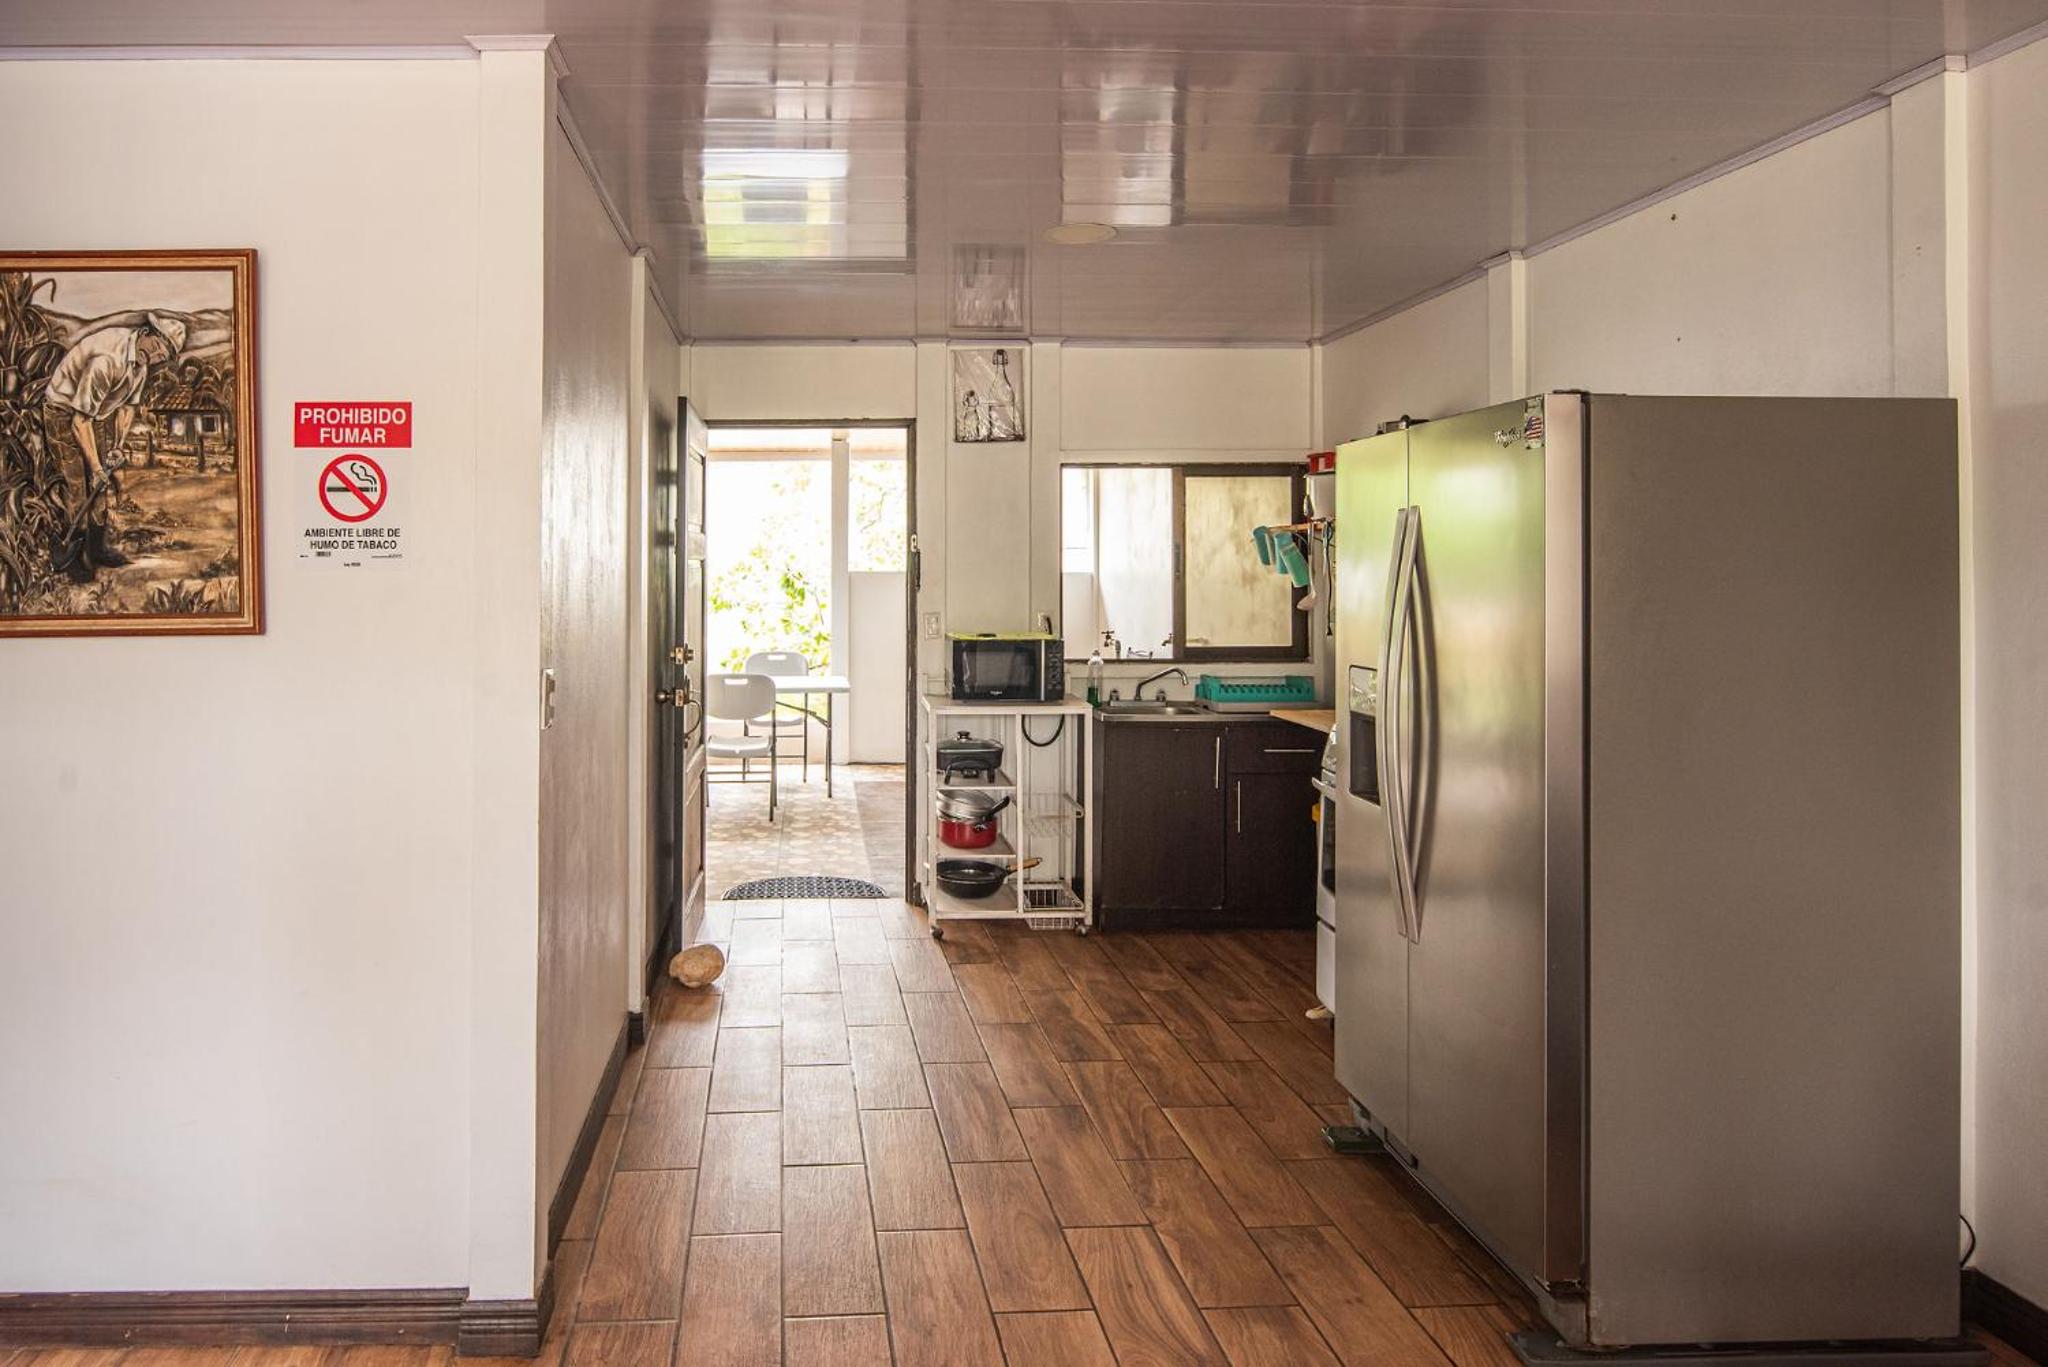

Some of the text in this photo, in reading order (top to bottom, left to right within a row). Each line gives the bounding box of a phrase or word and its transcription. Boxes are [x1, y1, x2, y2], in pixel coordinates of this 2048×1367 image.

[300, 408, 406, 425] PROHIBIDO
[319, 428, 386, 444] FUMAR
[304, 528, 401, 538] AMBIENTE LIBRE DE
[310, 540, 397, 550] HUMO DE TABACO
